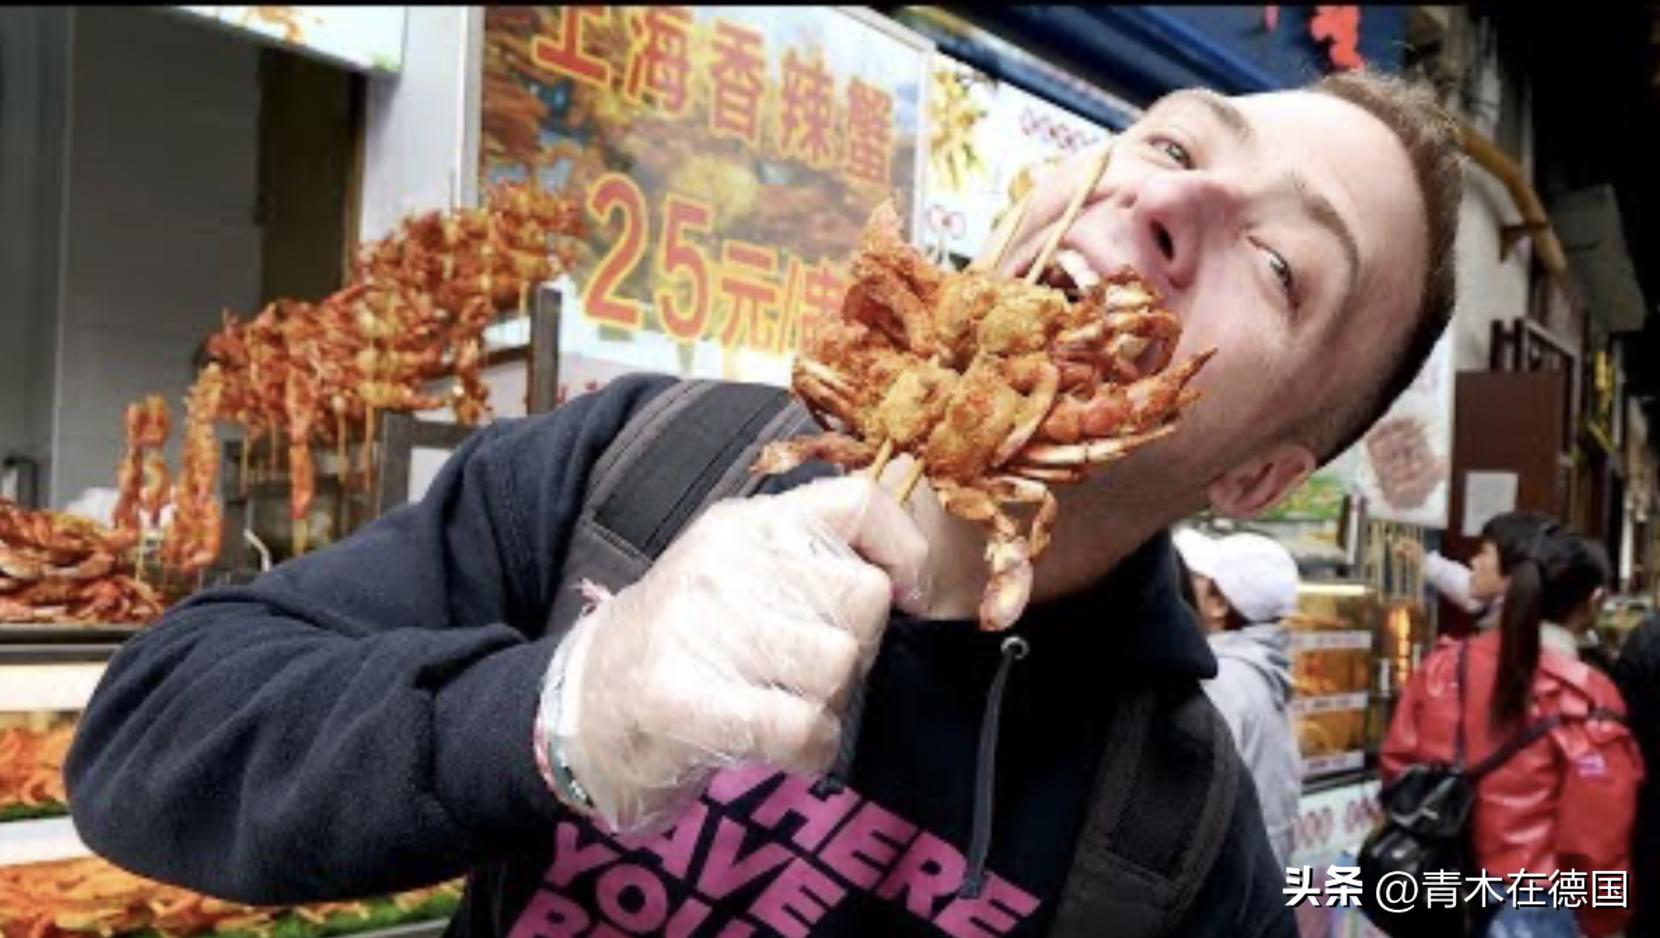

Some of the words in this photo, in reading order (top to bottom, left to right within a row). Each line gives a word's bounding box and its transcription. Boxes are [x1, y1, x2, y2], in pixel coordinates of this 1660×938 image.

[531, 6, 894, 189] 上海香辣蟹
[594, 799, 847, 938] AVE
